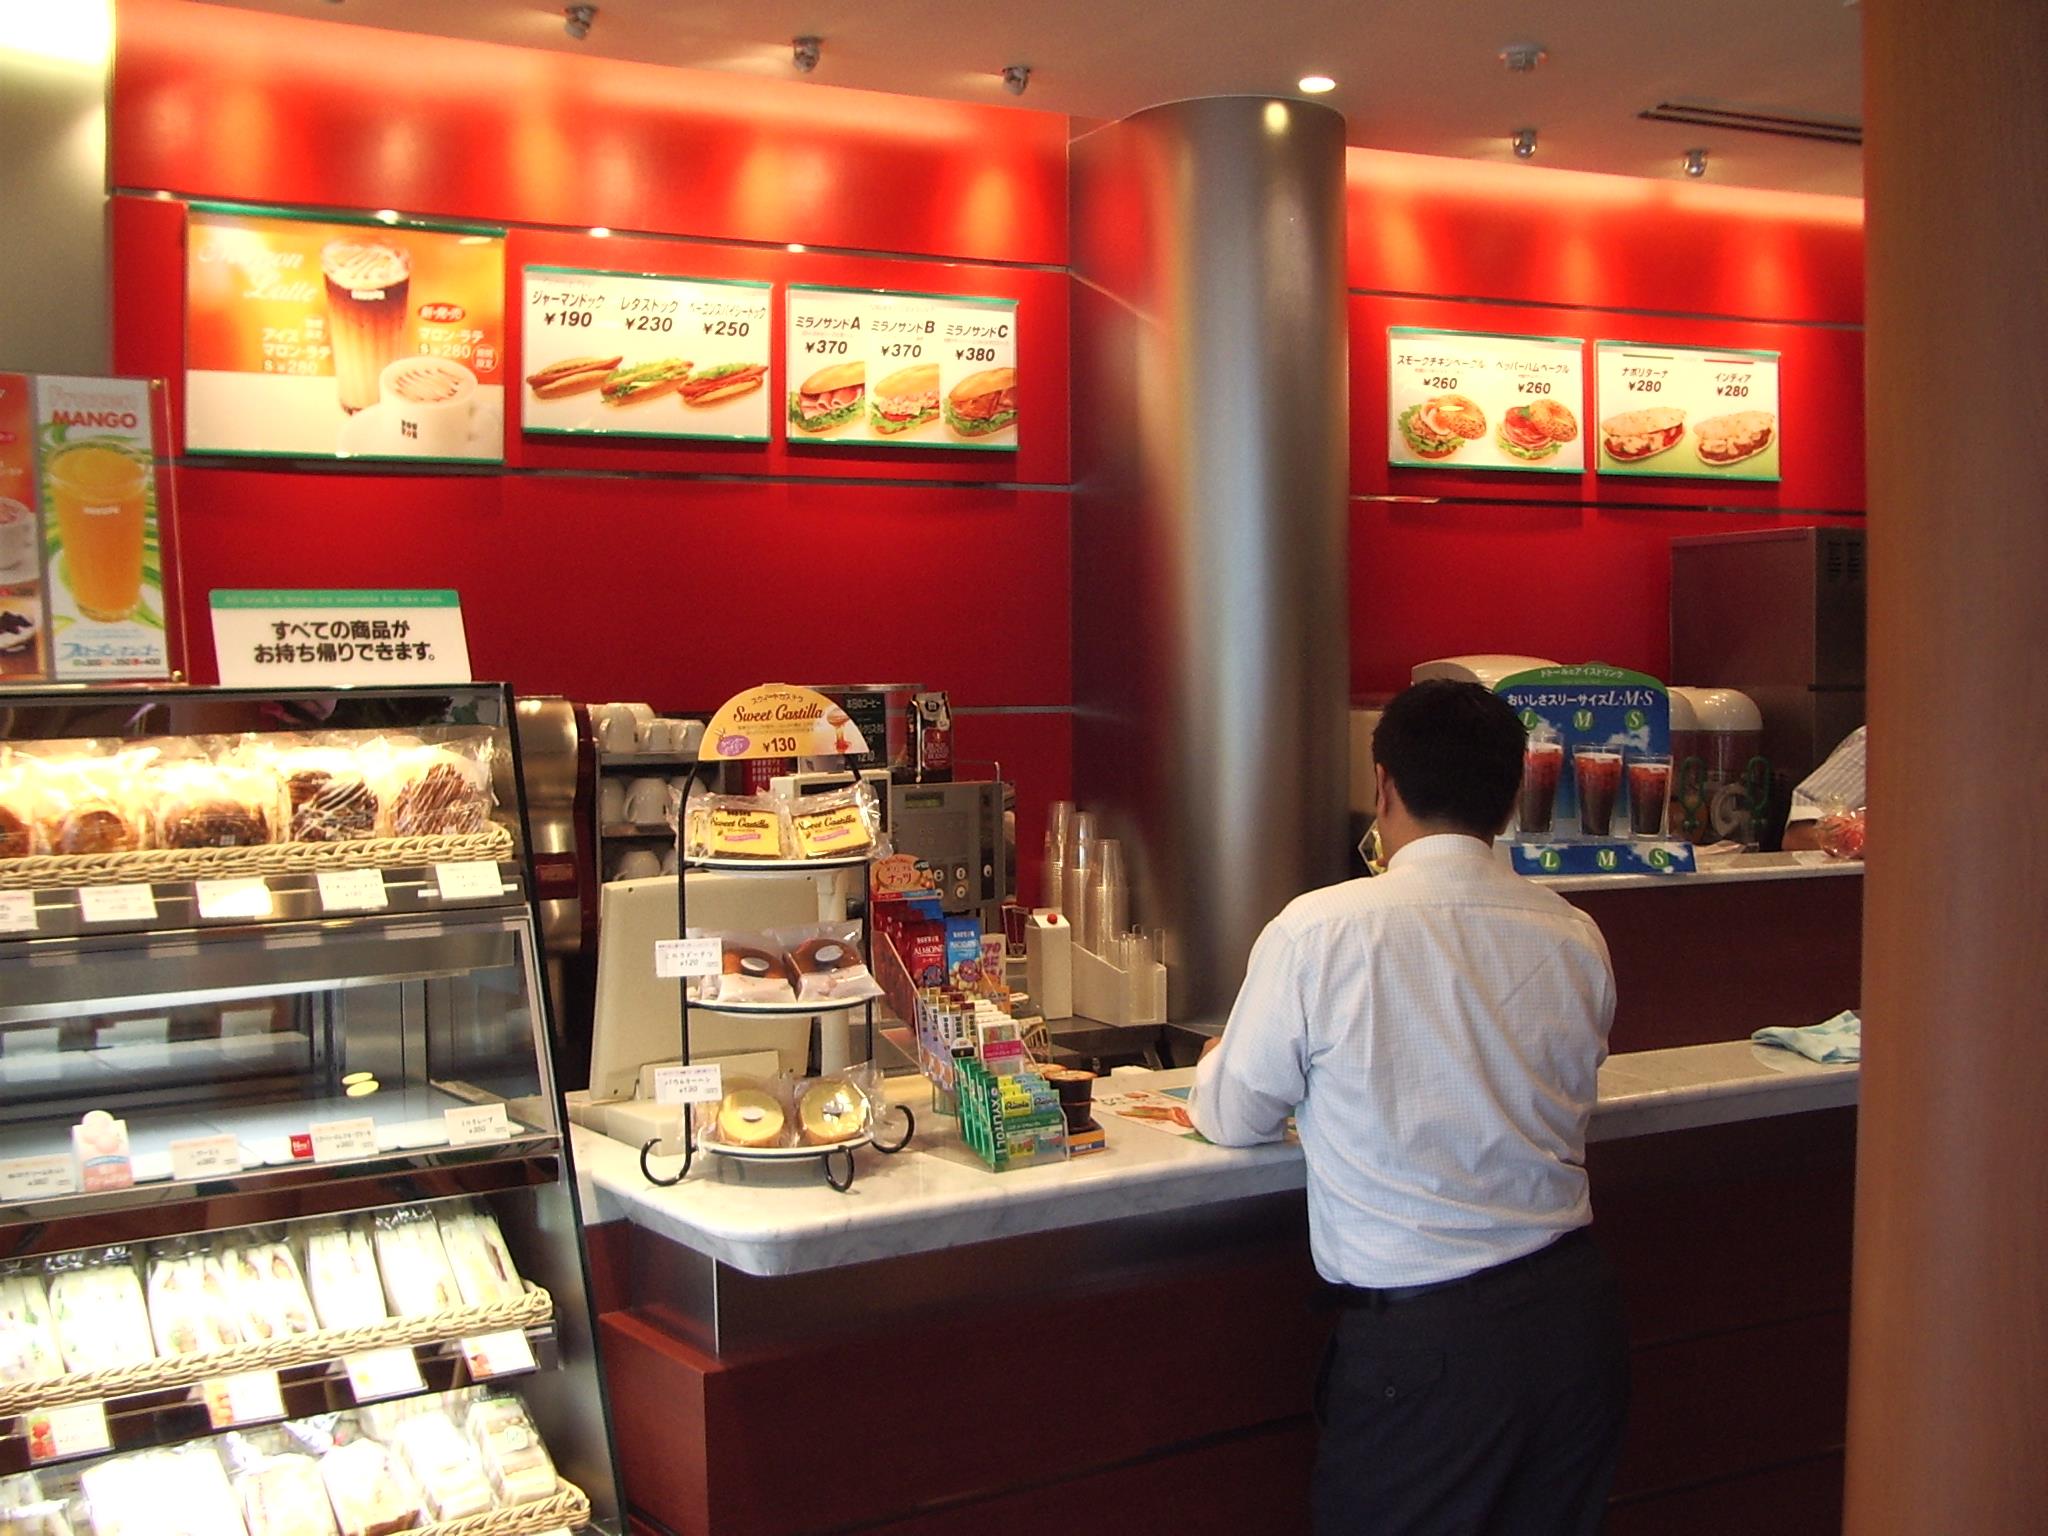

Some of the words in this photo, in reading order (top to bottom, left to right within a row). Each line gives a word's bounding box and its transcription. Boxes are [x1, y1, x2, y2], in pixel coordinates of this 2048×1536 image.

[544, 310, 593, 328] ¥190
[625, 315, 674, 333] ¥230
[703, 320, 750, 338] ¥250
[805, 339, 849, 355] ¥370
[881, 343, 922, 358] ¥370
[955, 347, 996, 362] ¥380
[1423, 376, 1458, 390] ¥260
[1518, 381, 1551, 395] ¥260
[1628, 380, 1662, 393] ¥280
[1717, 385, 1749, 398] ¥280
[52, 409, 138, 428] MANGO
[271, 620, 411, 640] すべての商品が
[254, 641, 436, 663] お持ち帰りできます。
[733, 705, 773, 723] Sweet
[775, 703, 823, 721] Castilla
[1523, 711, 1535, 728] L
[1574, 711, 1592, 728] M
[1629, 710, 1639, 727] S
[1544, 852, 1557, 868] L
[1598, 851, 1617, 867] M
[1654, 850, 1665, 866] S
